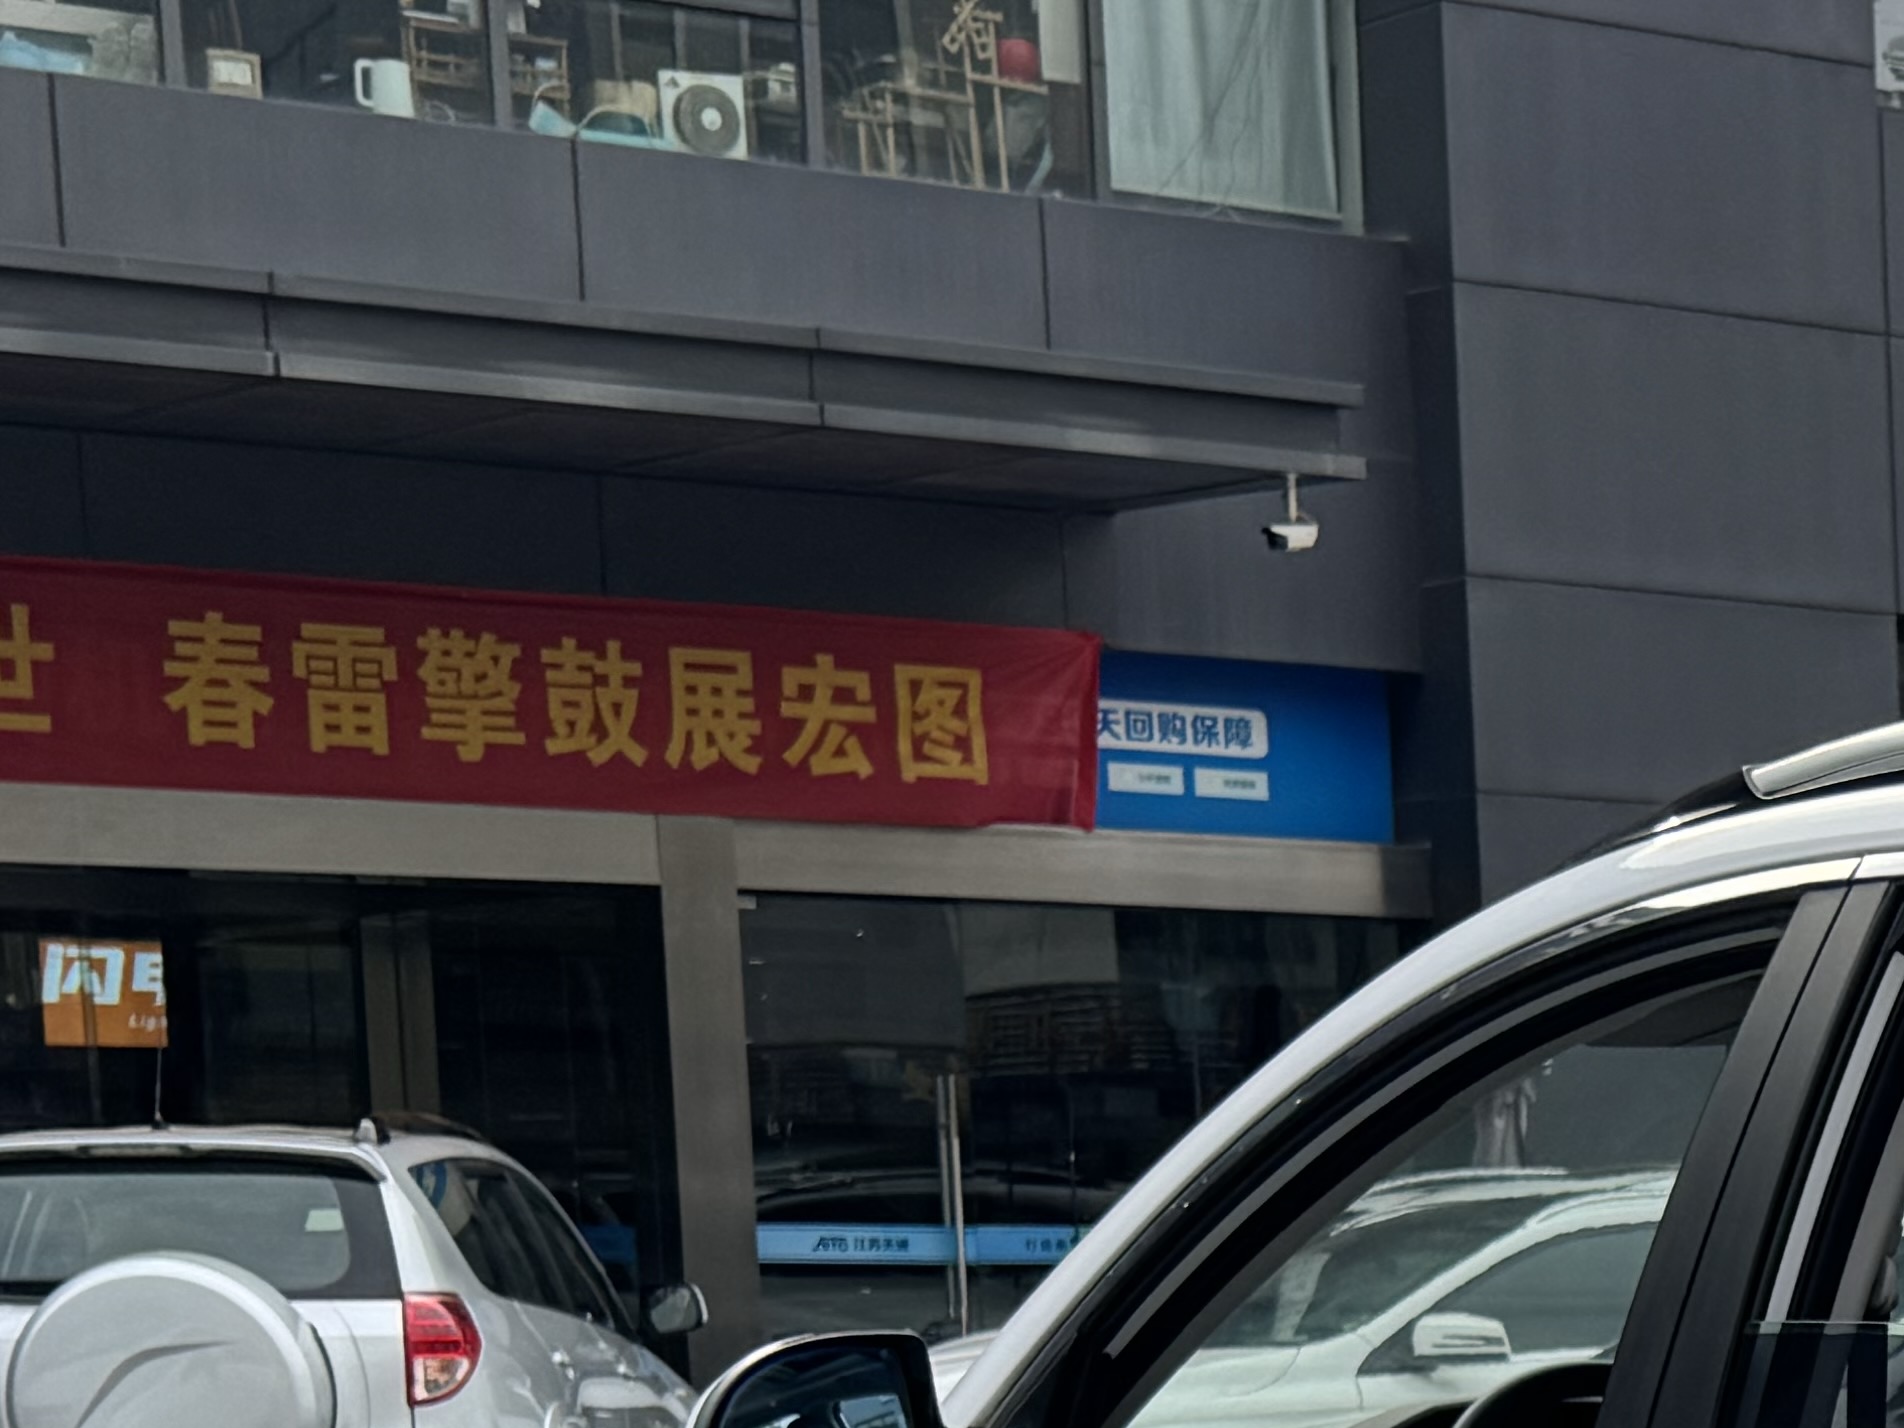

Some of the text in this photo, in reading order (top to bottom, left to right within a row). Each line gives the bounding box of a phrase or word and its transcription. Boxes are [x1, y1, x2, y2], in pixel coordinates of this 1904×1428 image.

[163, 610, 989, 786] 春雷擎鼓展宏图
